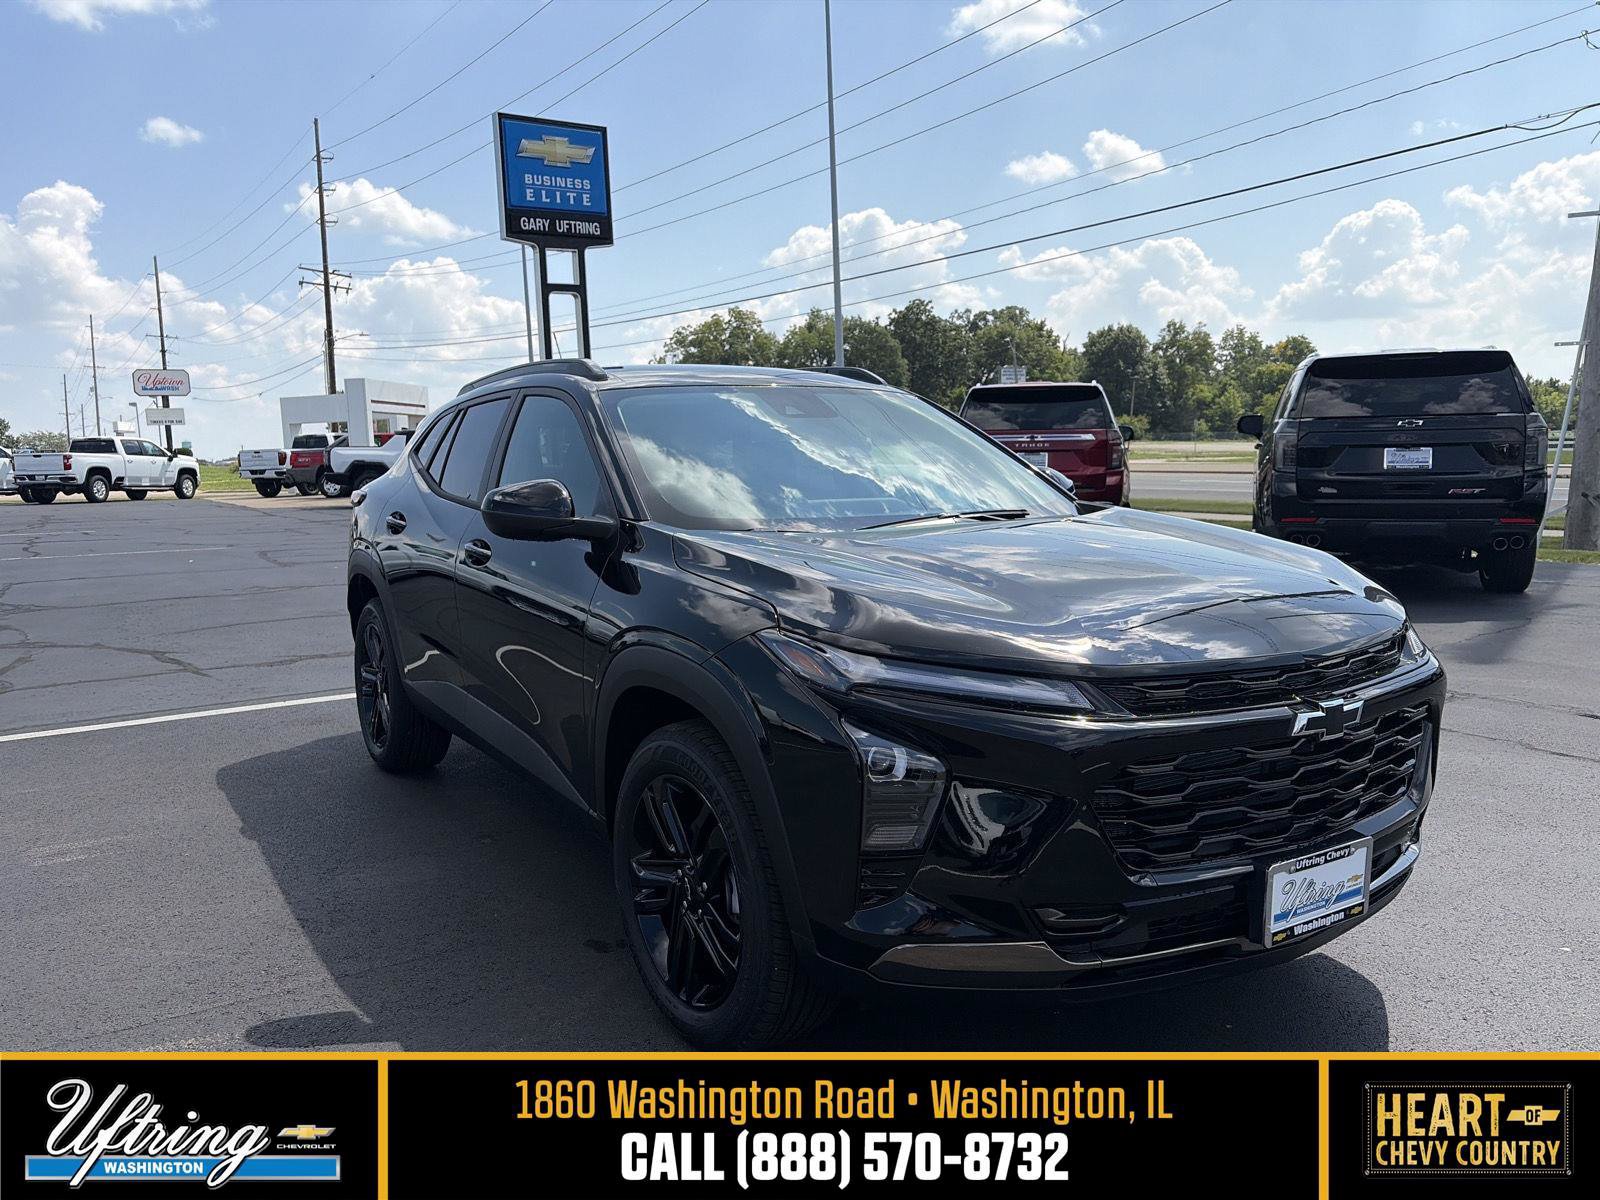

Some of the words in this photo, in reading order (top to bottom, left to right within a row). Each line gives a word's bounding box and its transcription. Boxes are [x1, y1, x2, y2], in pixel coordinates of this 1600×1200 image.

[524, 173, 591, 190] BUSINESS
[525, 188, 592, 206] ELITE
[520, 217, 550, 232] GARY
[556, 219, 601, 235] UFTRING
[137, 372, 184, 388] Uptown
[1296, 856, 1325, 869] Uftring
[1326, 847, 1350, 860] Chevy
[1281, 878, 1345, 922] Uftring
[1294, 911, 1344, 935] Washington
